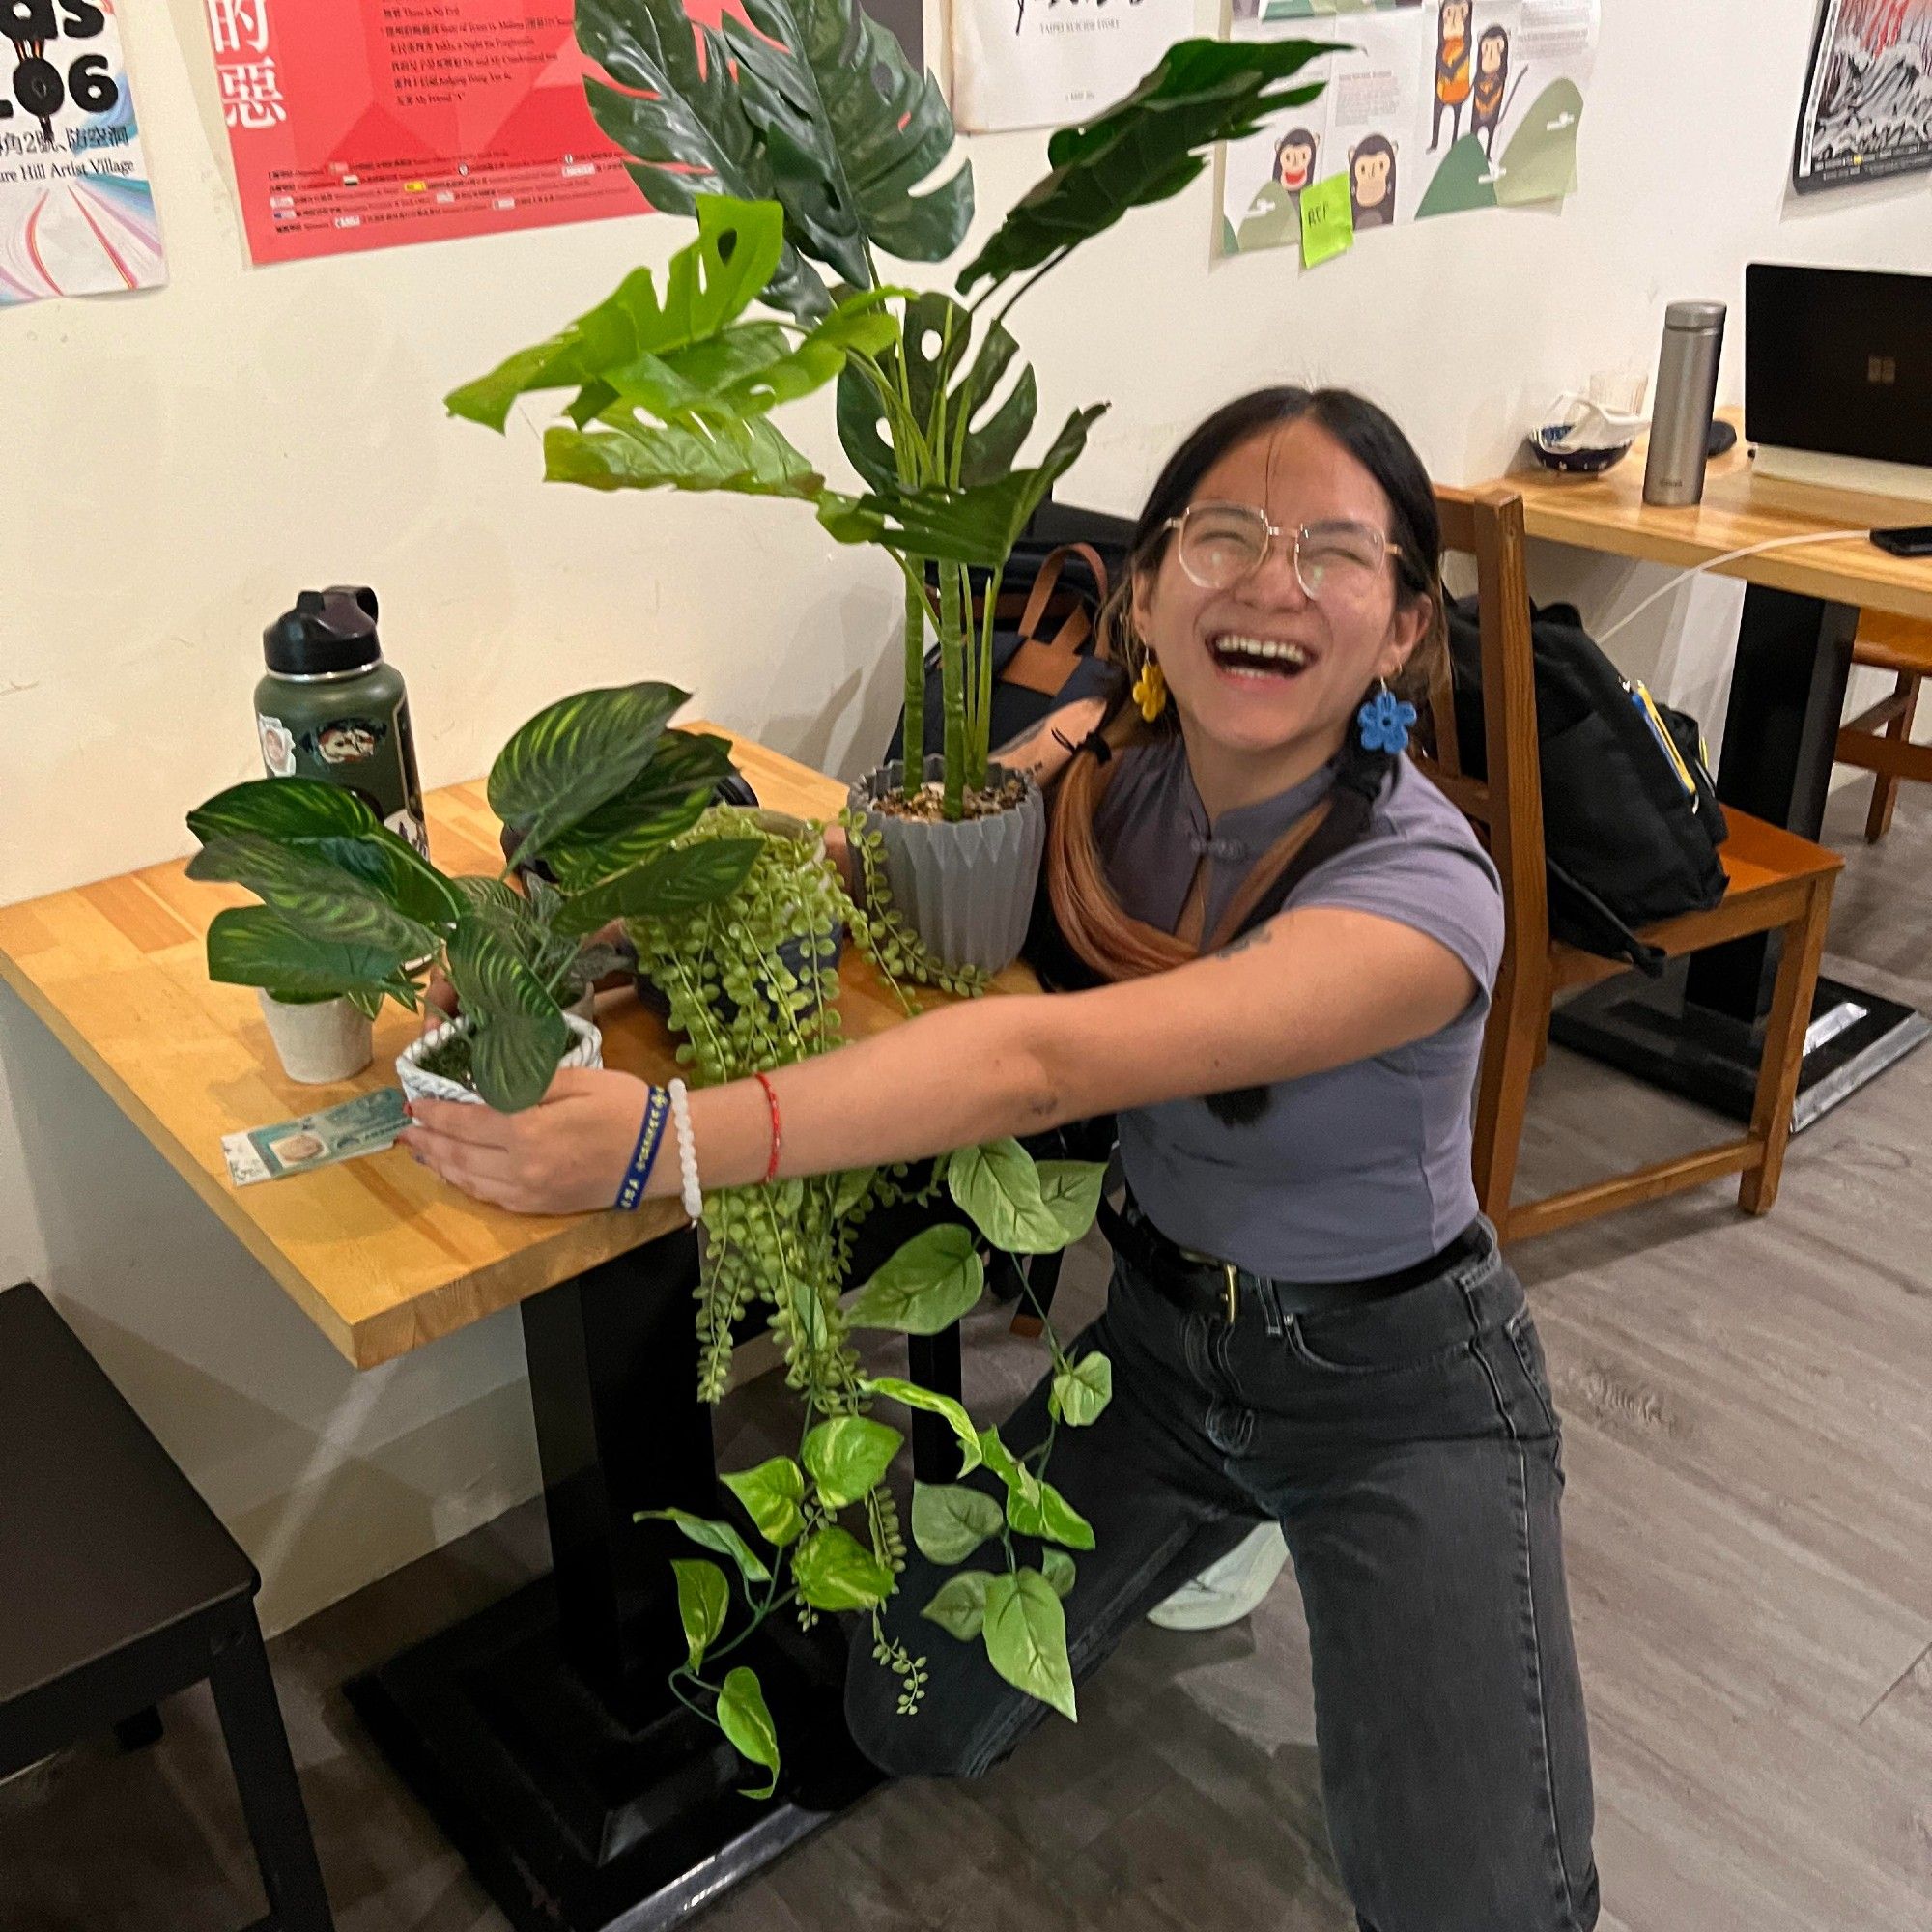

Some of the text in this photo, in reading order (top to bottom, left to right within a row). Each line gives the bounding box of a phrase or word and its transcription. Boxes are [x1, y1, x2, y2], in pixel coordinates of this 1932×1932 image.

[19, 163, 45, 181] Hill
[50, 159, 88, 179] Artist
[89, 156, 134, 177] Village
